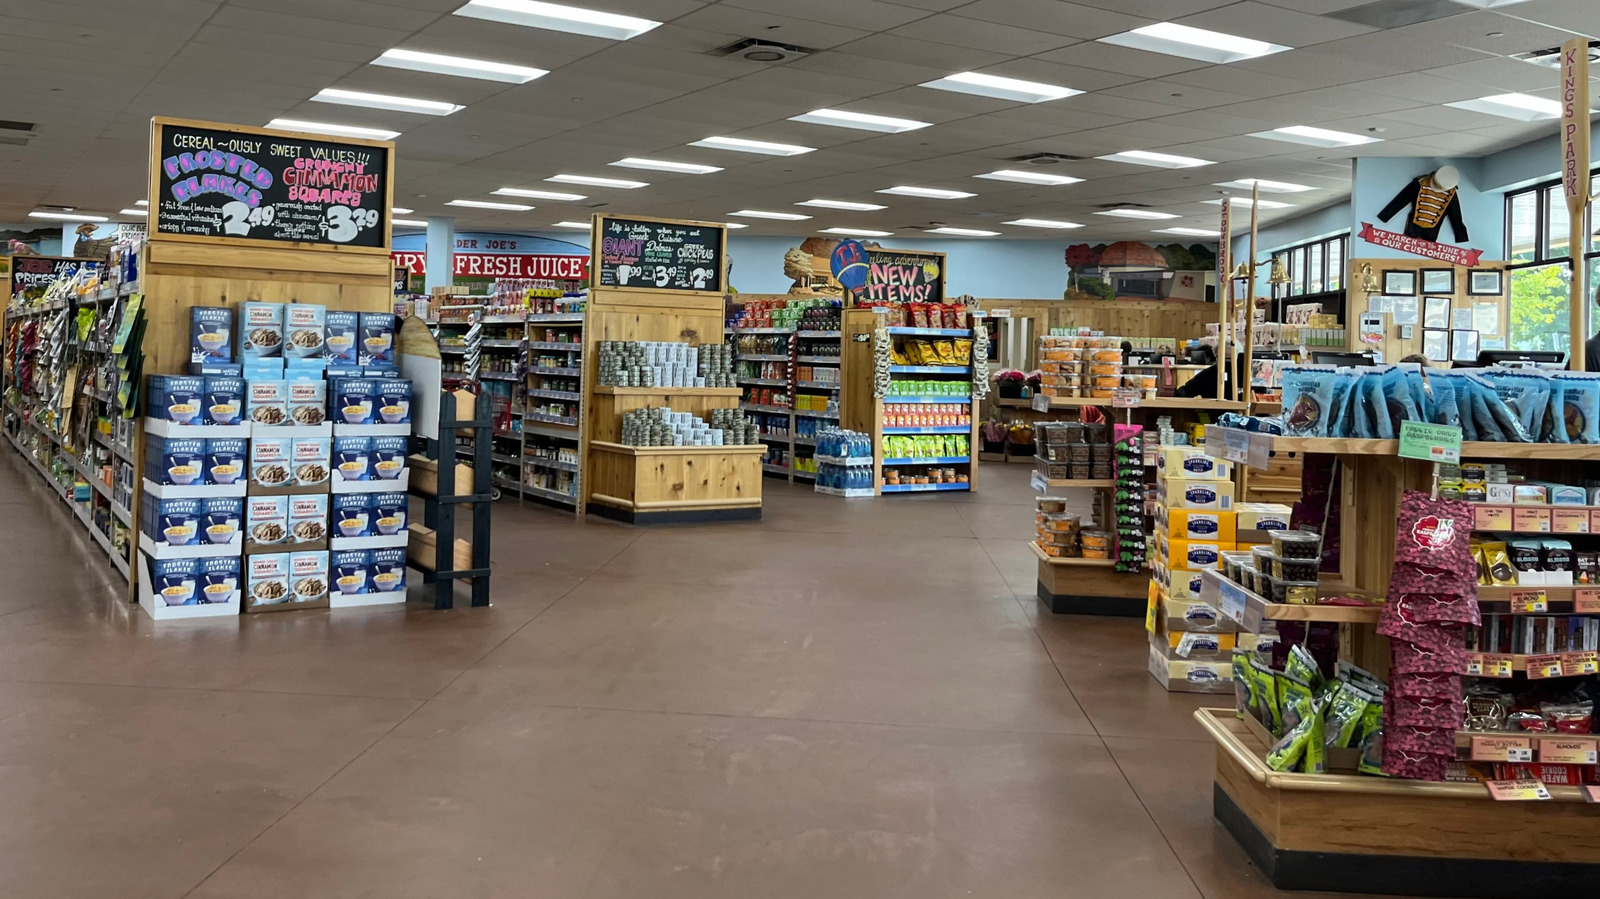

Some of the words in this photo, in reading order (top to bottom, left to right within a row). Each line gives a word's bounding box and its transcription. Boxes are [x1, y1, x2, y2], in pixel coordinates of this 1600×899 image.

[1564, 48, 1578, 118] KINGS
[270, 144, 302, 158] SWEET
[310, 146, 370, 166] VALUES!!!
[1565, 123, 1578, 198] PARK
[163, 150, 273, 189] FROSTED
[294, 158, 366, 174] CRUNCHY
[282, 168, 378, 192] CINNAMON
[171, 174, 263, 208] FLAKES
[288, 186, 362, 207] SQUARES
[212, 201, 275, 236] $2.49
[319, 205, 379, 242] $3.29
[485, 240, 517, 249] JOE'S
[602, 237, 644, 256] GIANT
[1373, 230, 1386, 238] WE
[1387, 234, 1417, 246] MARCH
[1437, 245, 1459, 255] TUNE
[1382, 240, 1402, 248] OUR
[1404, 244, 1460, 262] CUSTOMERS!
[54, 261, 77, 272] HAS
[456, 255, 522, 276] FRESH
[527, 257, 582, 277] JUICE
[871, 264, 918, 286] NEW
[15, 272, 56, 284] PRICES
[868, 283, 931, 303] ITEMS!
[1406, 426, 1433, 434] FREEZE
[1406, 432, 1455, 443] RASPBERRIES
[1490, 487, 1511, 497] GUM
[1541, 766, 1567, 774] COOKIE
[1541, 774, 1568, 783] WAFER
